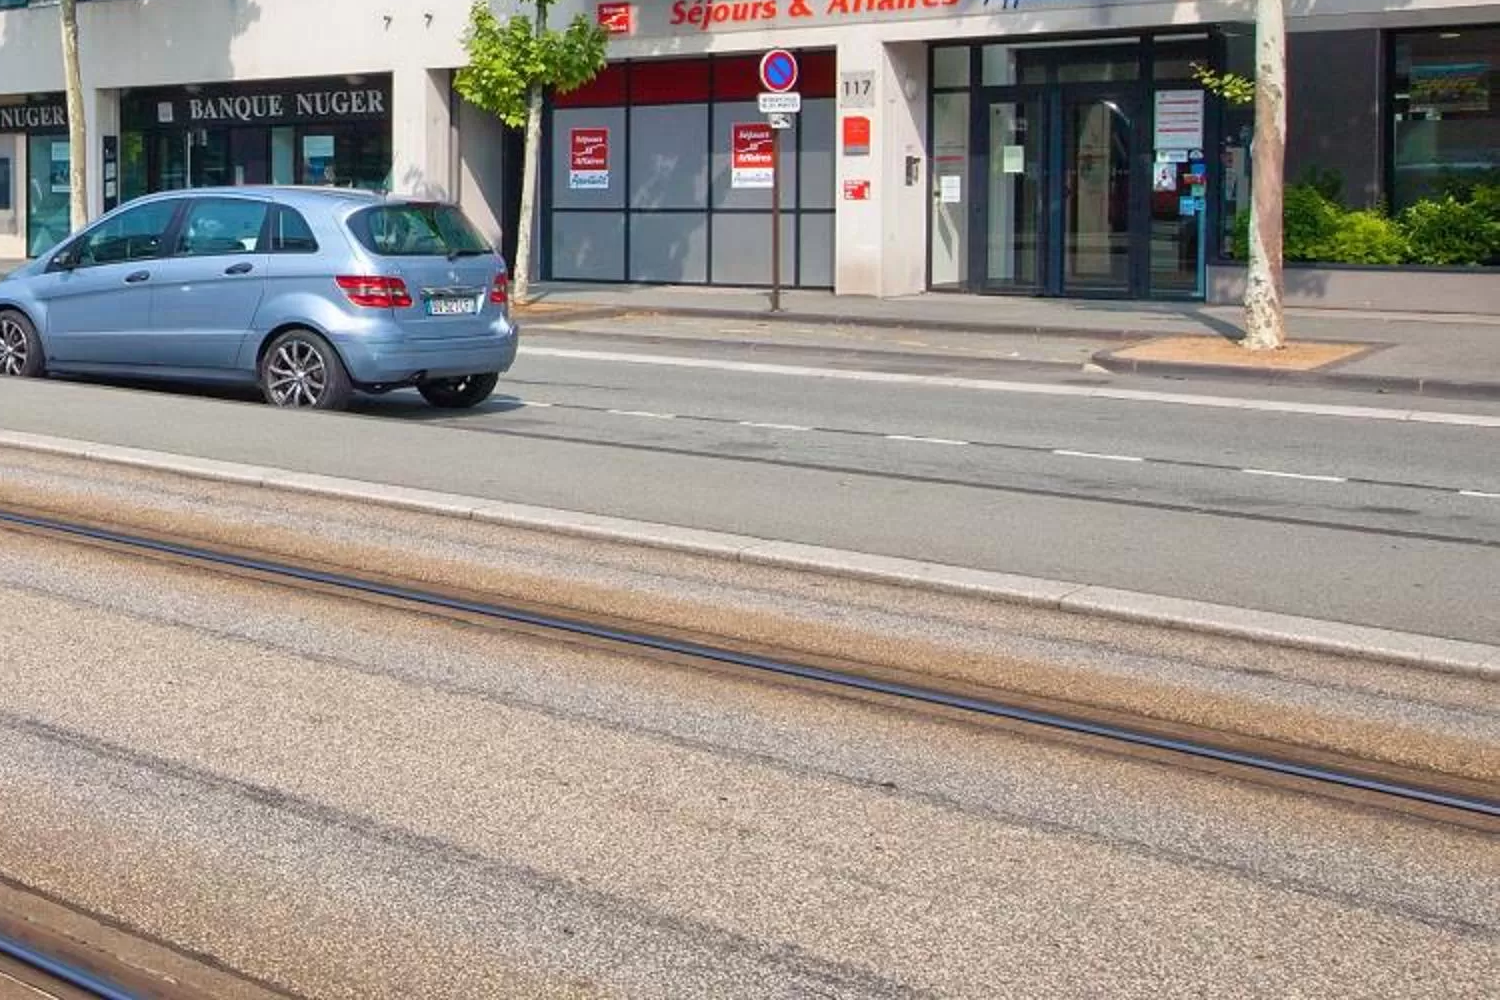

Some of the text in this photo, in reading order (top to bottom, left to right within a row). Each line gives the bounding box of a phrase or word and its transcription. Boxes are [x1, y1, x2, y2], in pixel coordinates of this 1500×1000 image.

[843, 79, 871, 96] 117
[0, 105, 66, 128] NUGER
[189, 89, 385, 121] BANQUE NUGER
